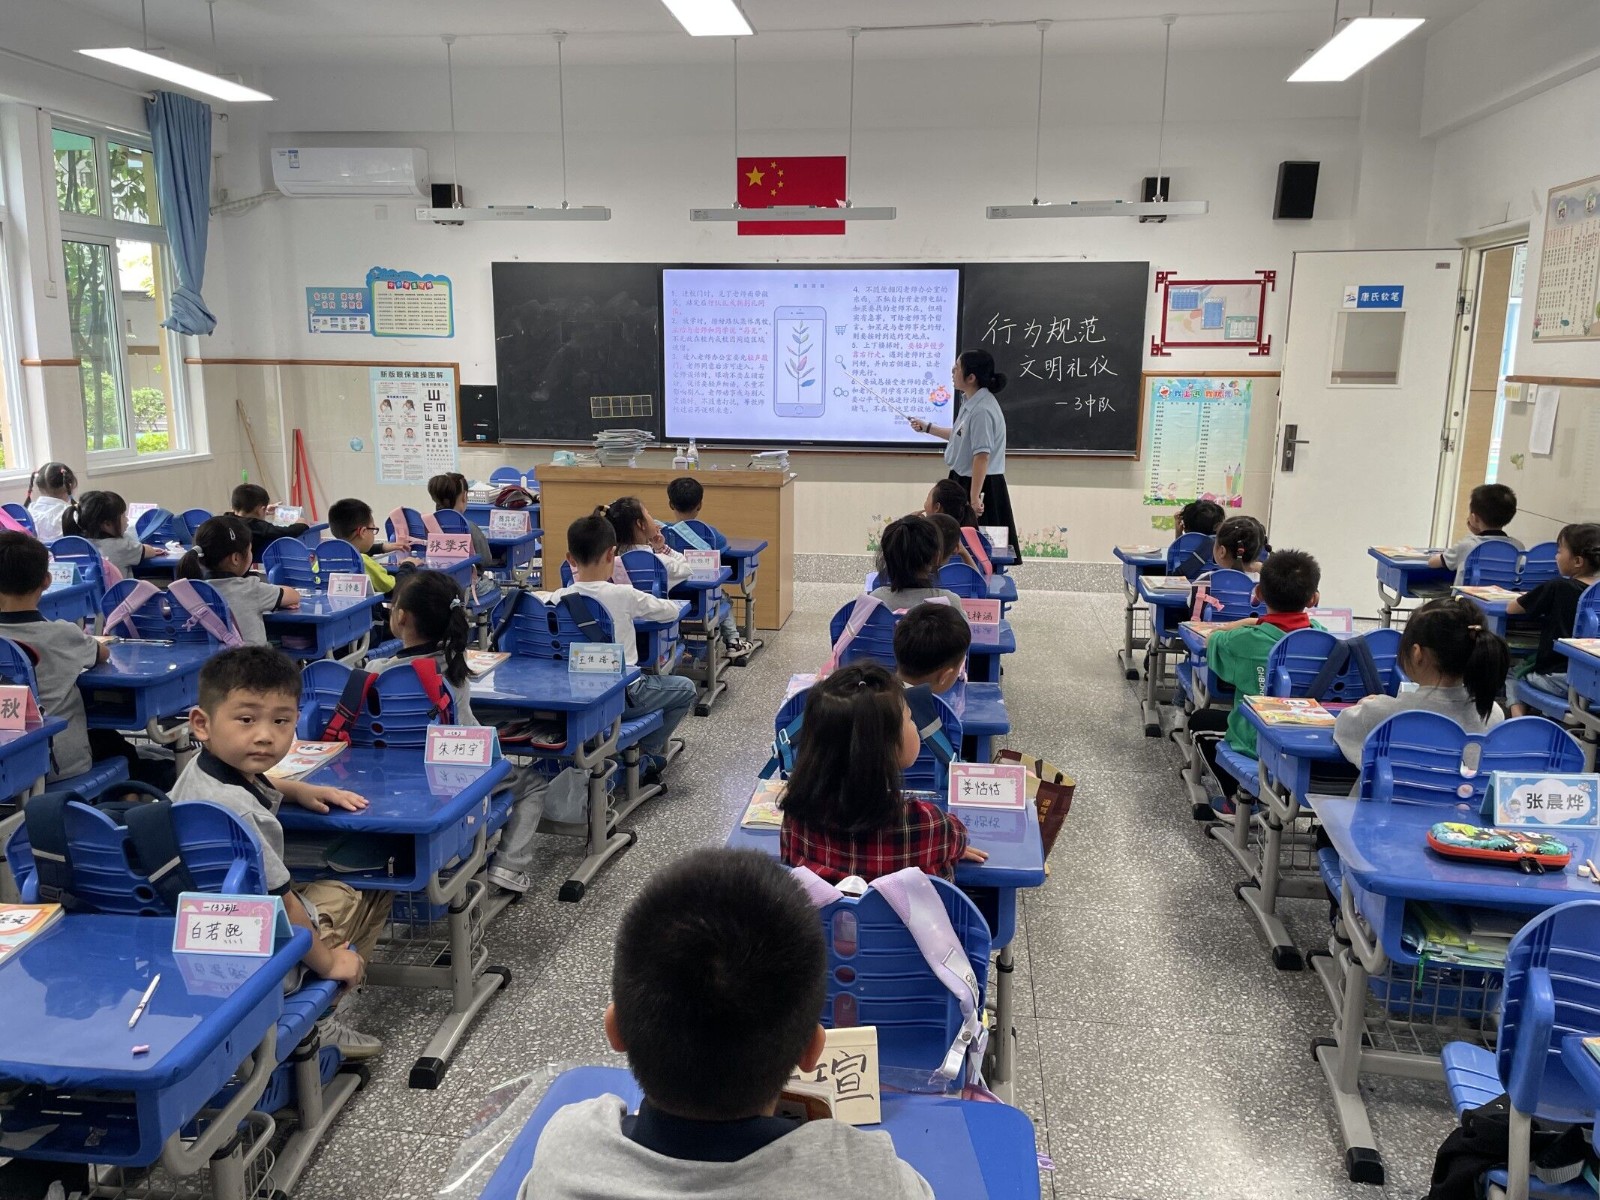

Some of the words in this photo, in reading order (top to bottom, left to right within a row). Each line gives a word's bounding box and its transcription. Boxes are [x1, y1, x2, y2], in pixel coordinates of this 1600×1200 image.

[981, 312, 1106, 348] 行为规范
[380, 370, 444, 379] 新版眼保健操图解
[1019, 355, 1118, 382] 文明礼仪
[429, 539, 470, 554] 张擎天
[1526, 793, 1584, 811] 张晨烨
